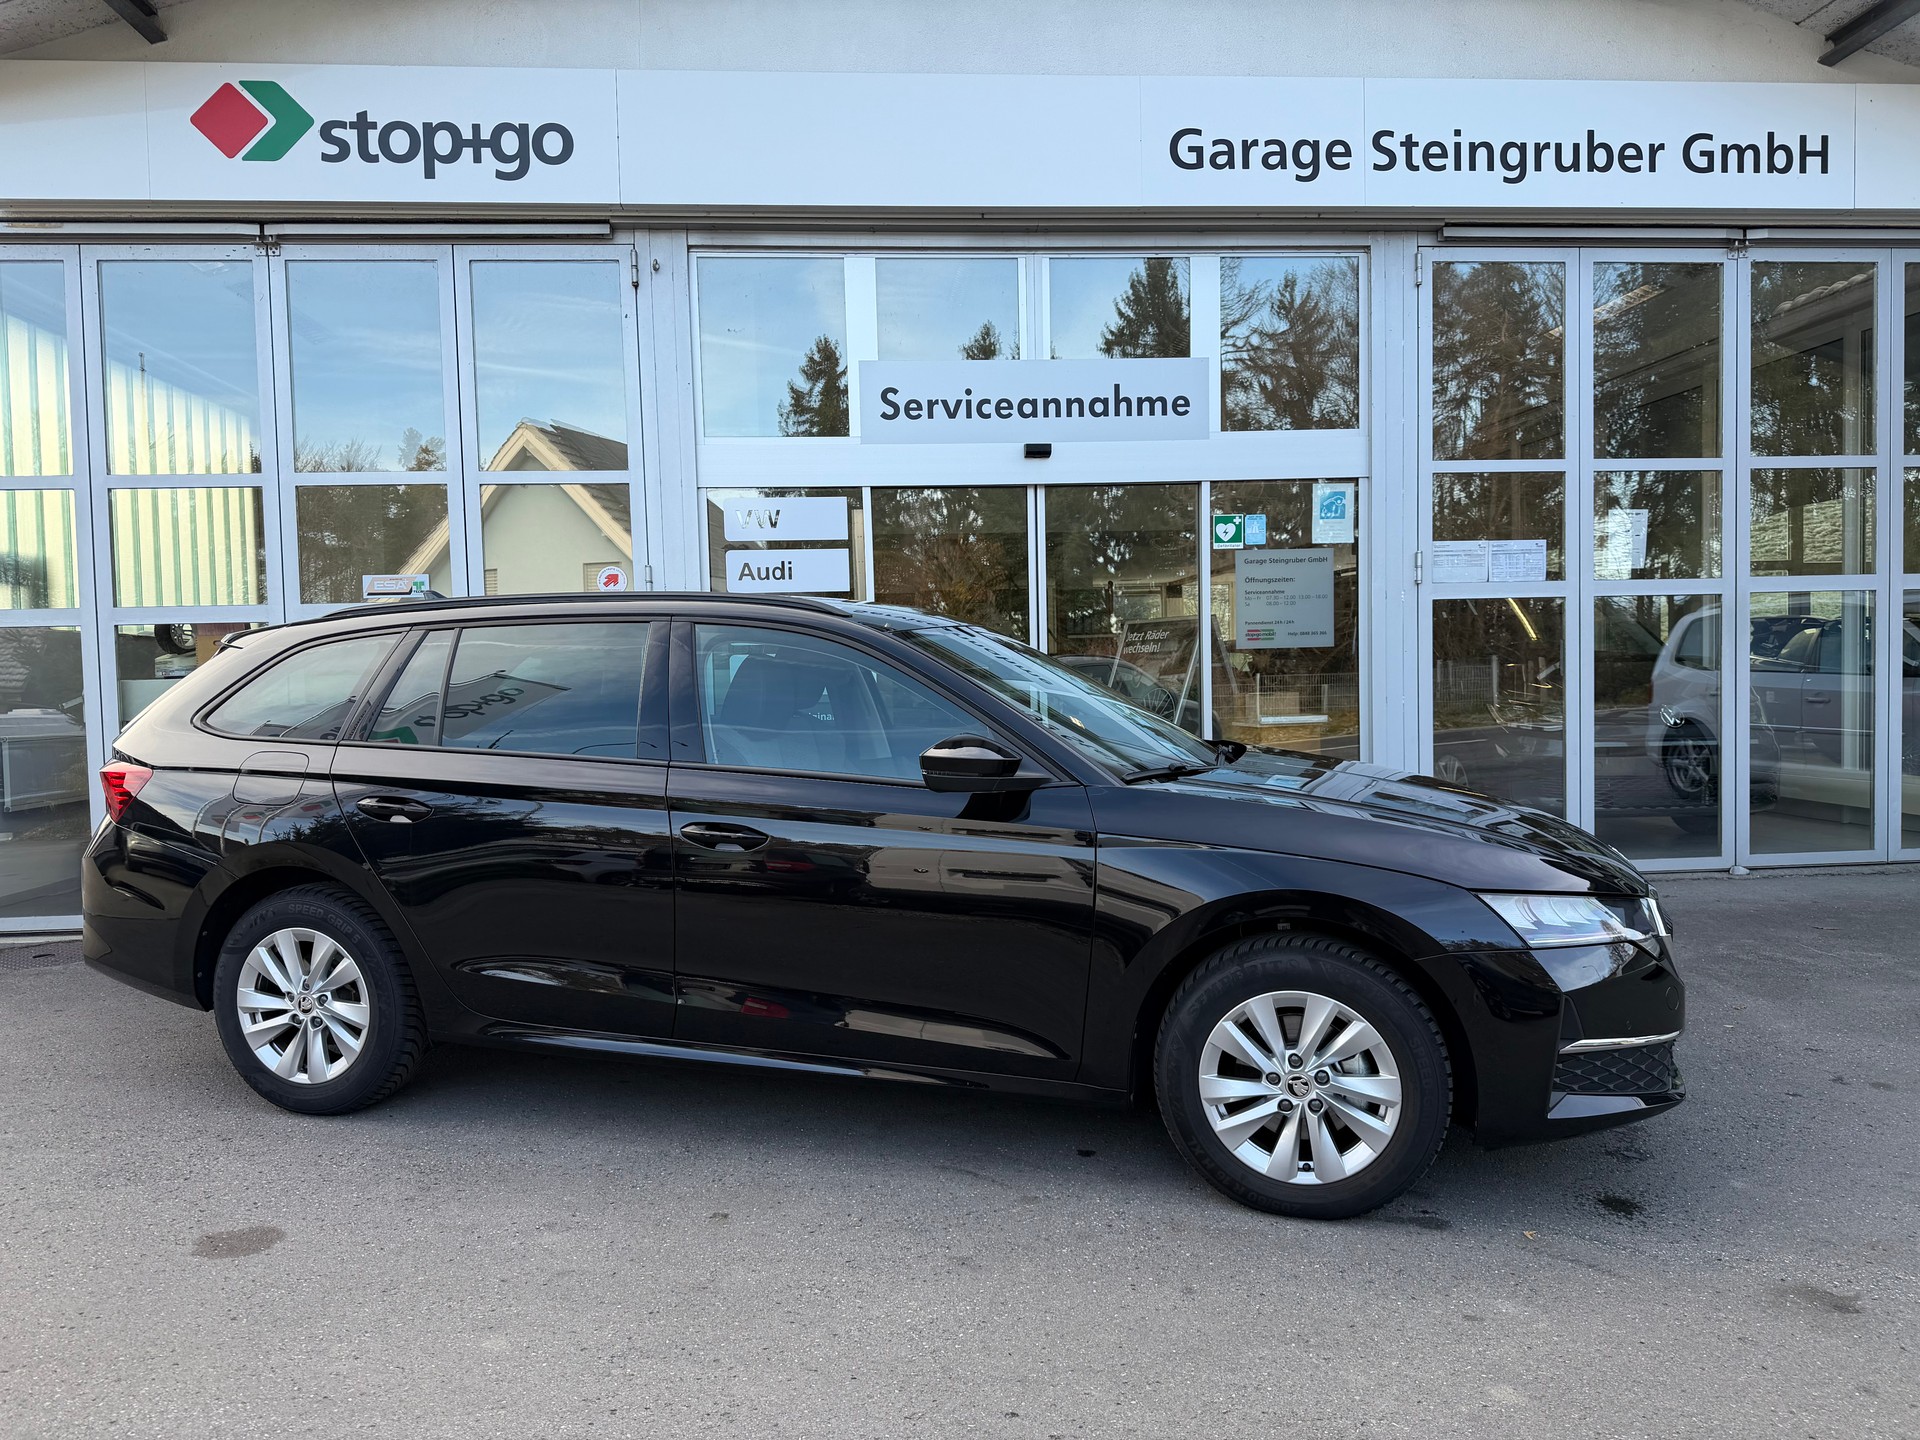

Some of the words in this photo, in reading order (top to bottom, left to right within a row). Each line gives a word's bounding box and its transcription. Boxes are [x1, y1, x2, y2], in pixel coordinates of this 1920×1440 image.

[319, 109, 575, 181] stop+go
[1169, 128, 1353, 183] Garage
[1372, 128, 1666, 184] Steingruber
[1682, 131, 1830, 175] GmbH
[879, 383, 1191, 421] Serviceannahme
[736, 509, 780, 529] VW
[738, 561, 793, 581] Audi
[1269, 557, 1306, 565] Steingruber
[1145, 629, 1169, 640] Räder
[1123, 642, 1161, 654] wechseln!
